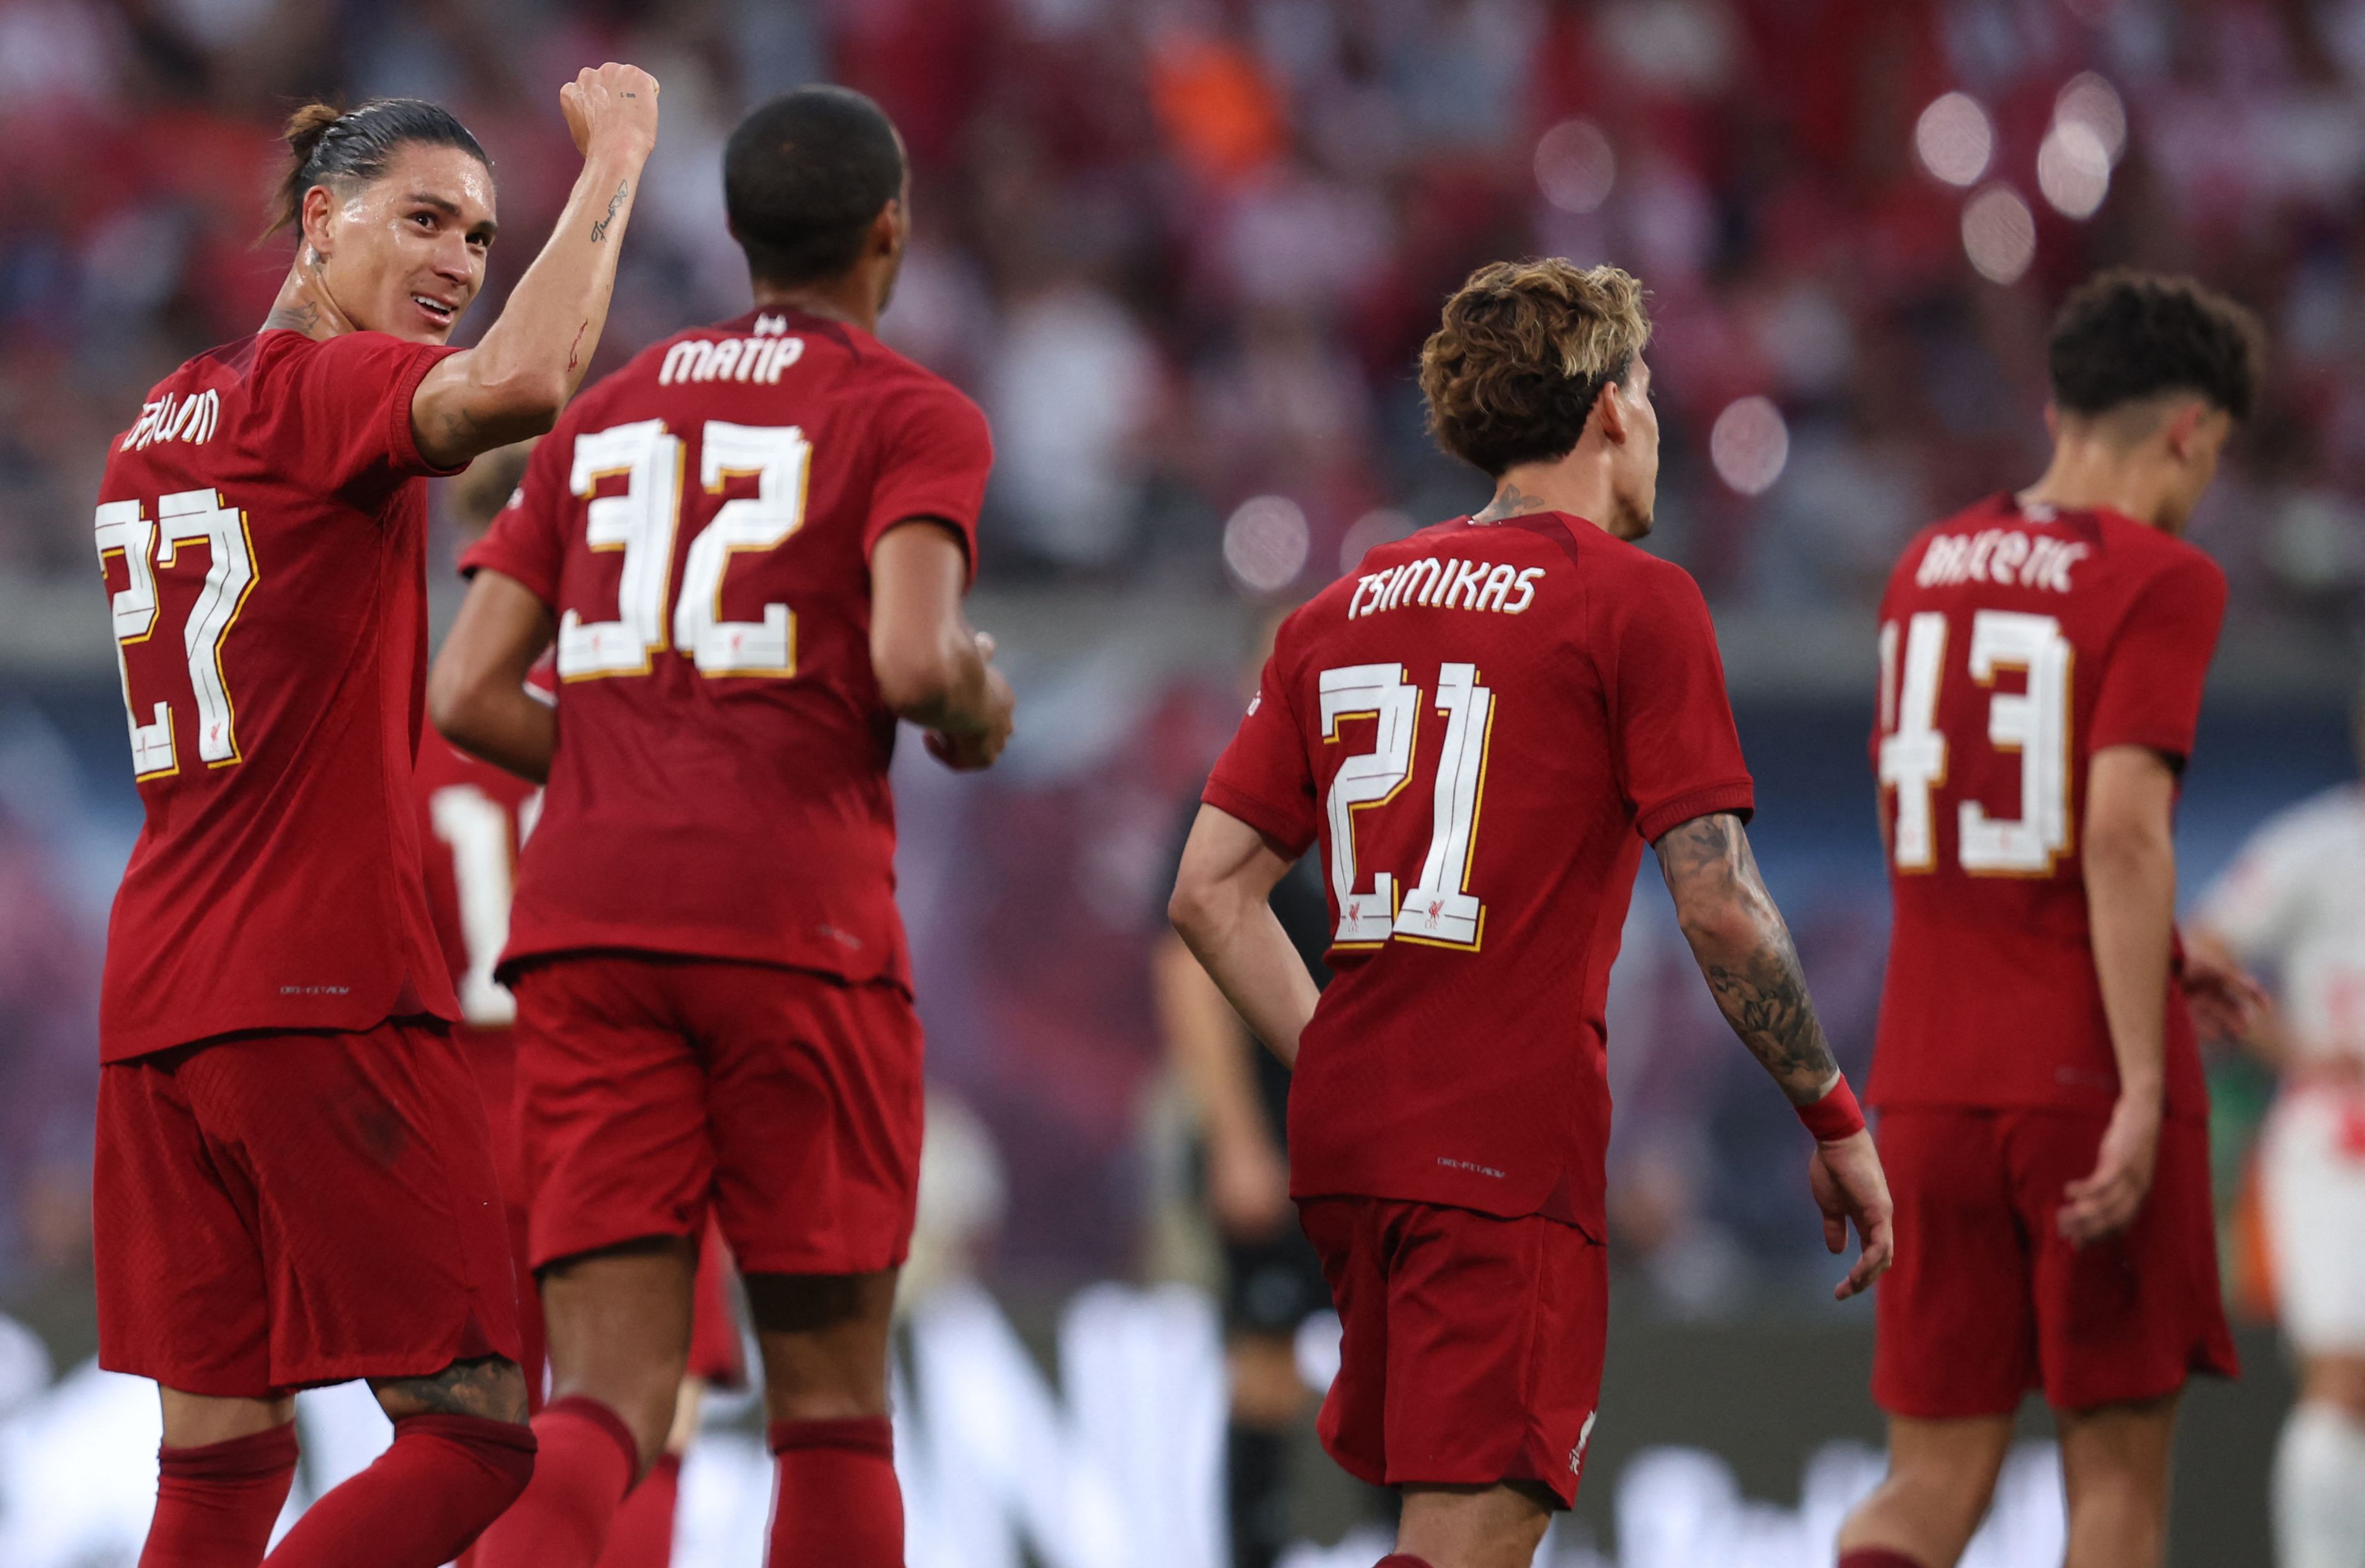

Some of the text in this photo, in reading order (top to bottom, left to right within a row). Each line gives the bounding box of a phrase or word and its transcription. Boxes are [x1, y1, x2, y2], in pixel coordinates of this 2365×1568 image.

[659, 338, 803, 385] MATIP
[95, 488, 259, 782] 27
[558, 418, 812, 682] 32
[1348, 558, 1545, 619] TSIMIKAS
[1320, 663, 1496, 952] 21
[1880, 610, 2074, 875] 43
[430, 784, 543, 1026] 1
